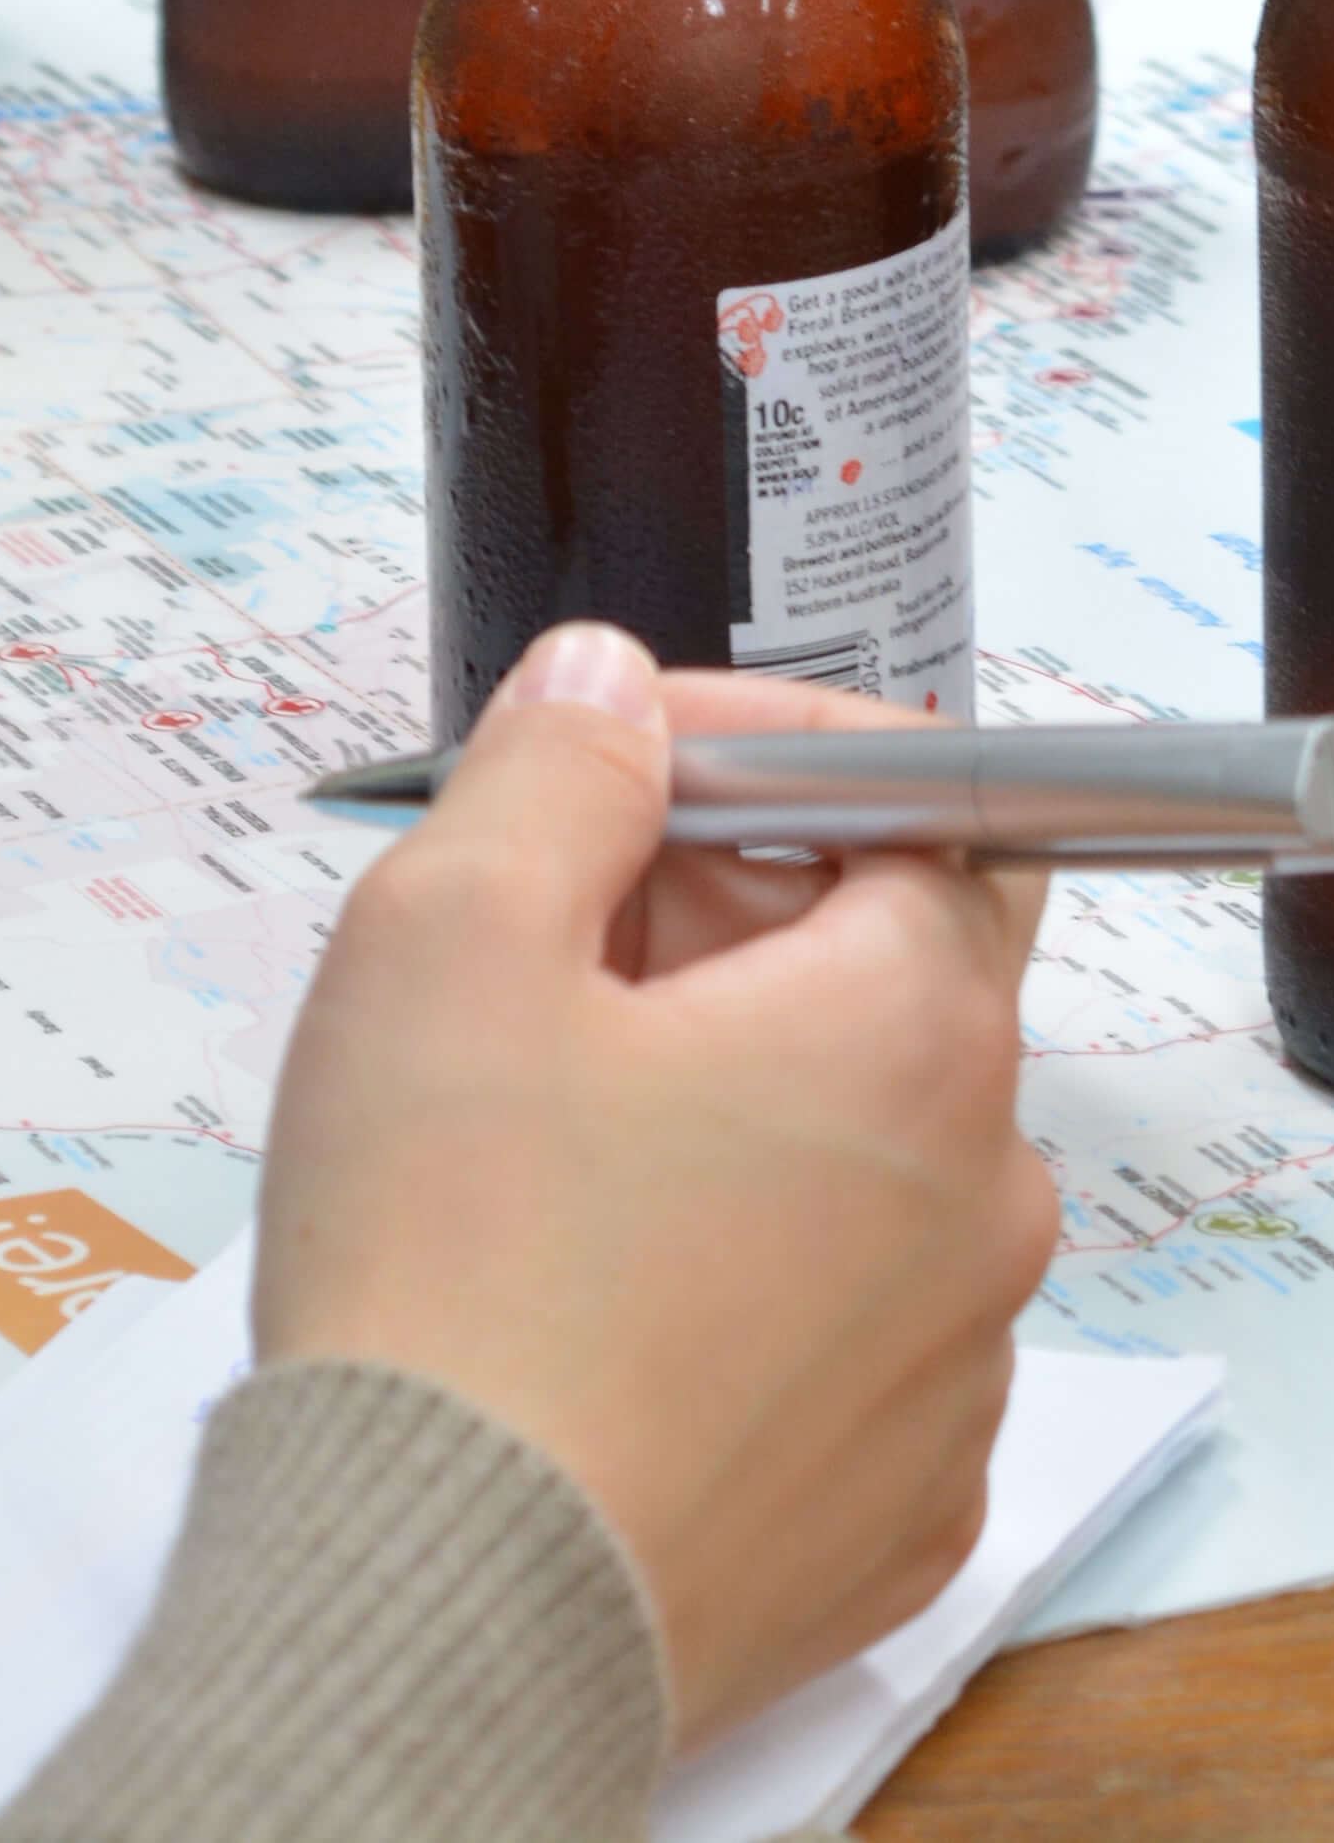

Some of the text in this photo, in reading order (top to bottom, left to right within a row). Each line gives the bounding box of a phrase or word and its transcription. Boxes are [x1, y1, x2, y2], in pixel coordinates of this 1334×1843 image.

[787, 277, 880, 314] Get a good
[787, 311, 835, 337] Feral
[841, 291, 904, 325] Brewing
[782, 335, 857, 363] explodes
[807, 358, 839, 376] hop
[818, 374, 859, 401] solid
[754, 399, 805, 429] 10c
[824, 382, 920, 423] of American
[755, 429, 797, 444] REFUND
[755, 438, 821, 459] COLLECTION
[755, 455, 799, 472] DEPOTS
[756, 465, 820, 484] WHEN SOLD
[756, 488, 769, 498] IN
[782, 551, 836, 574] Brewed
[839, 540, 865, 562] and
[785, 577, 902, 619] Western Australia
